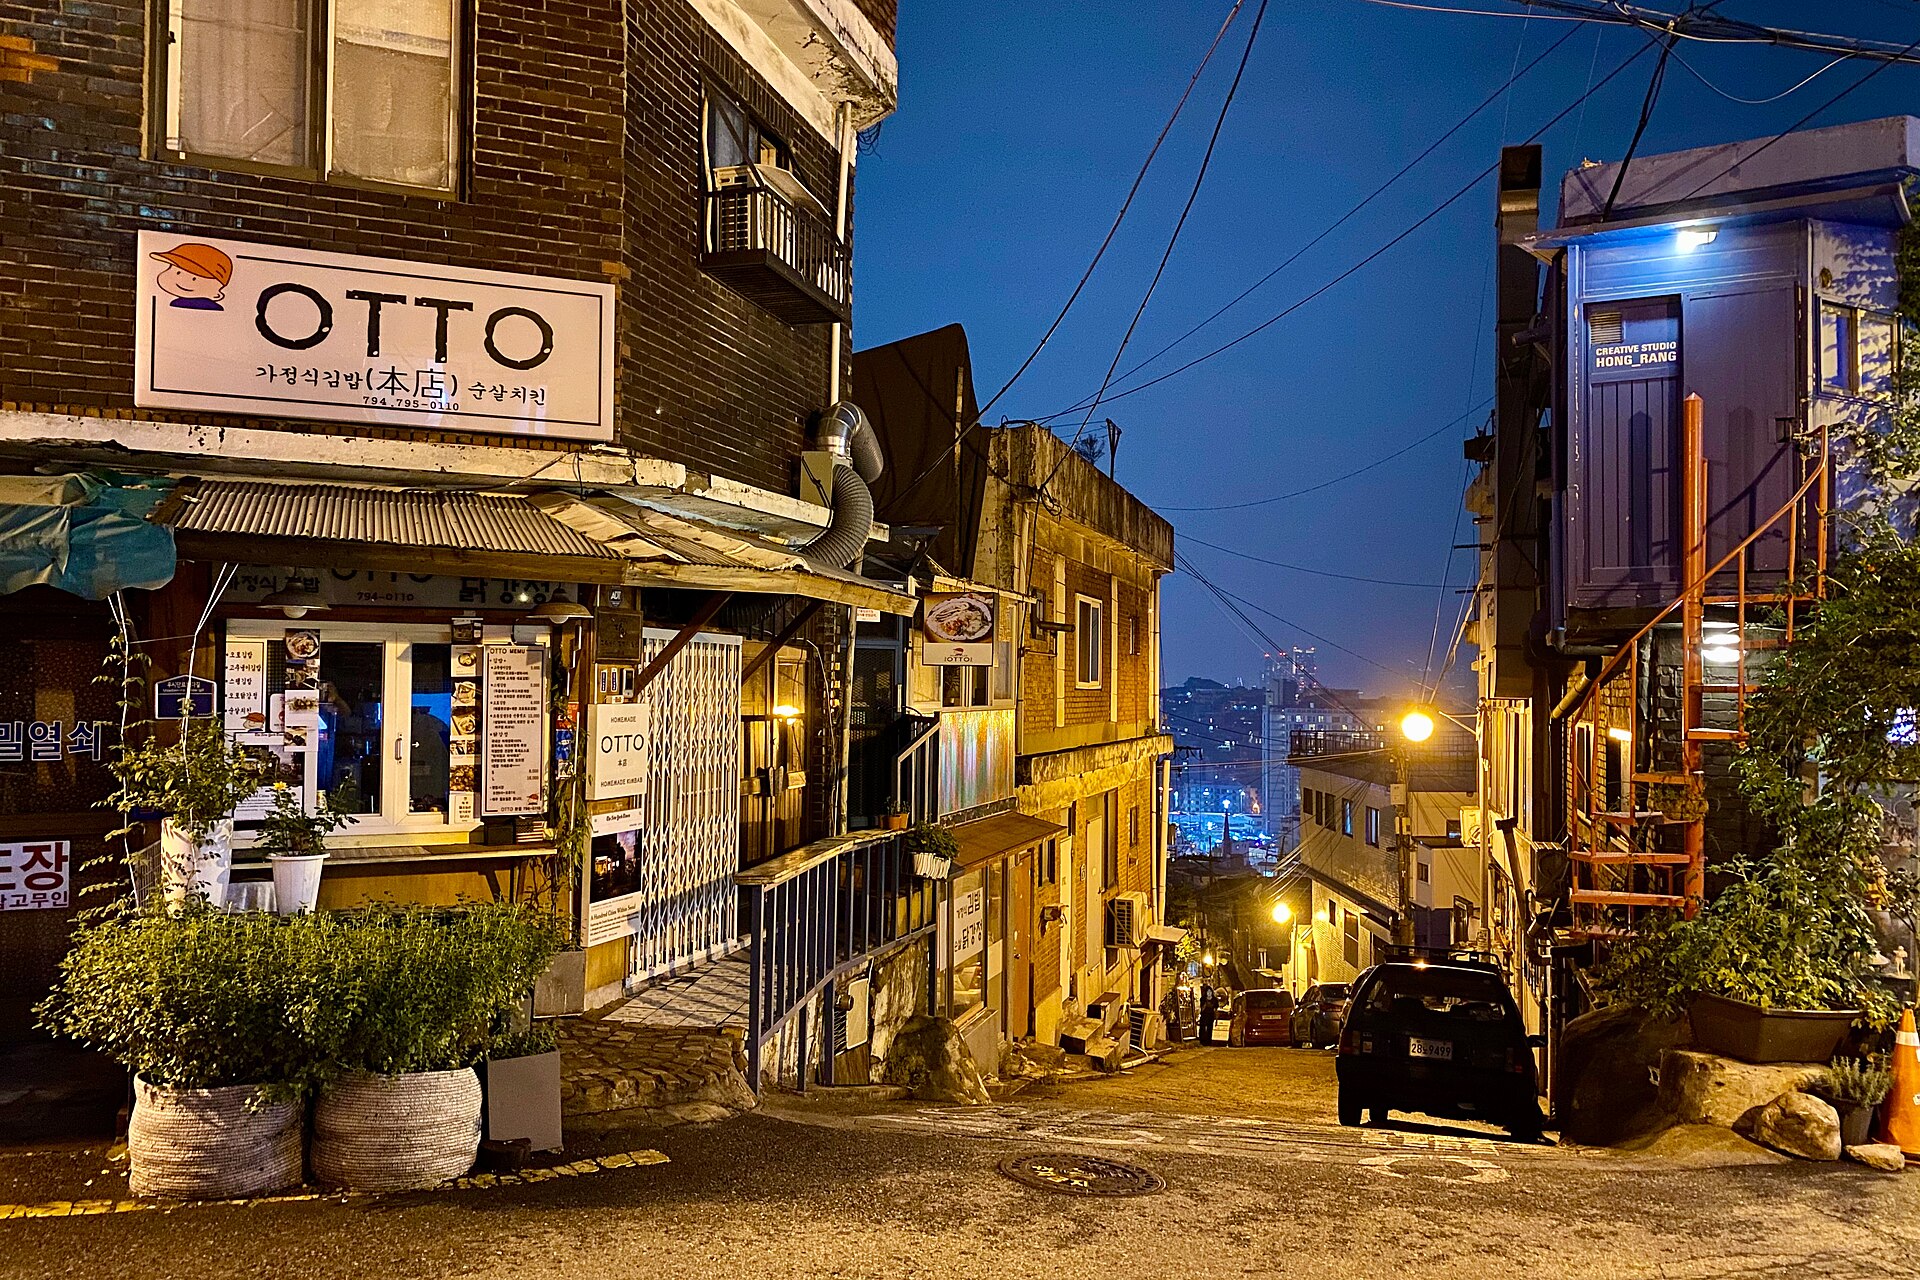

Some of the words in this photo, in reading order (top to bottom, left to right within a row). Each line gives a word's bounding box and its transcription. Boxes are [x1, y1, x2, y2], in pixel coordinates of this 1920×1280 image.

[255, 282, 554, 370] OTTO
[1596, 345, 1639, 356] CREATIVE
[1641, 341, 1677, 352] STUDIO
[1596, 351, 1677, 368] HONG_RANG
[467, 381, 546, 406] 순살치킨
[611, 591, 622, 600] ADT
[601, 734, 645, 754] OTTO
[600, 778, 626, 788] HOMEMADE
